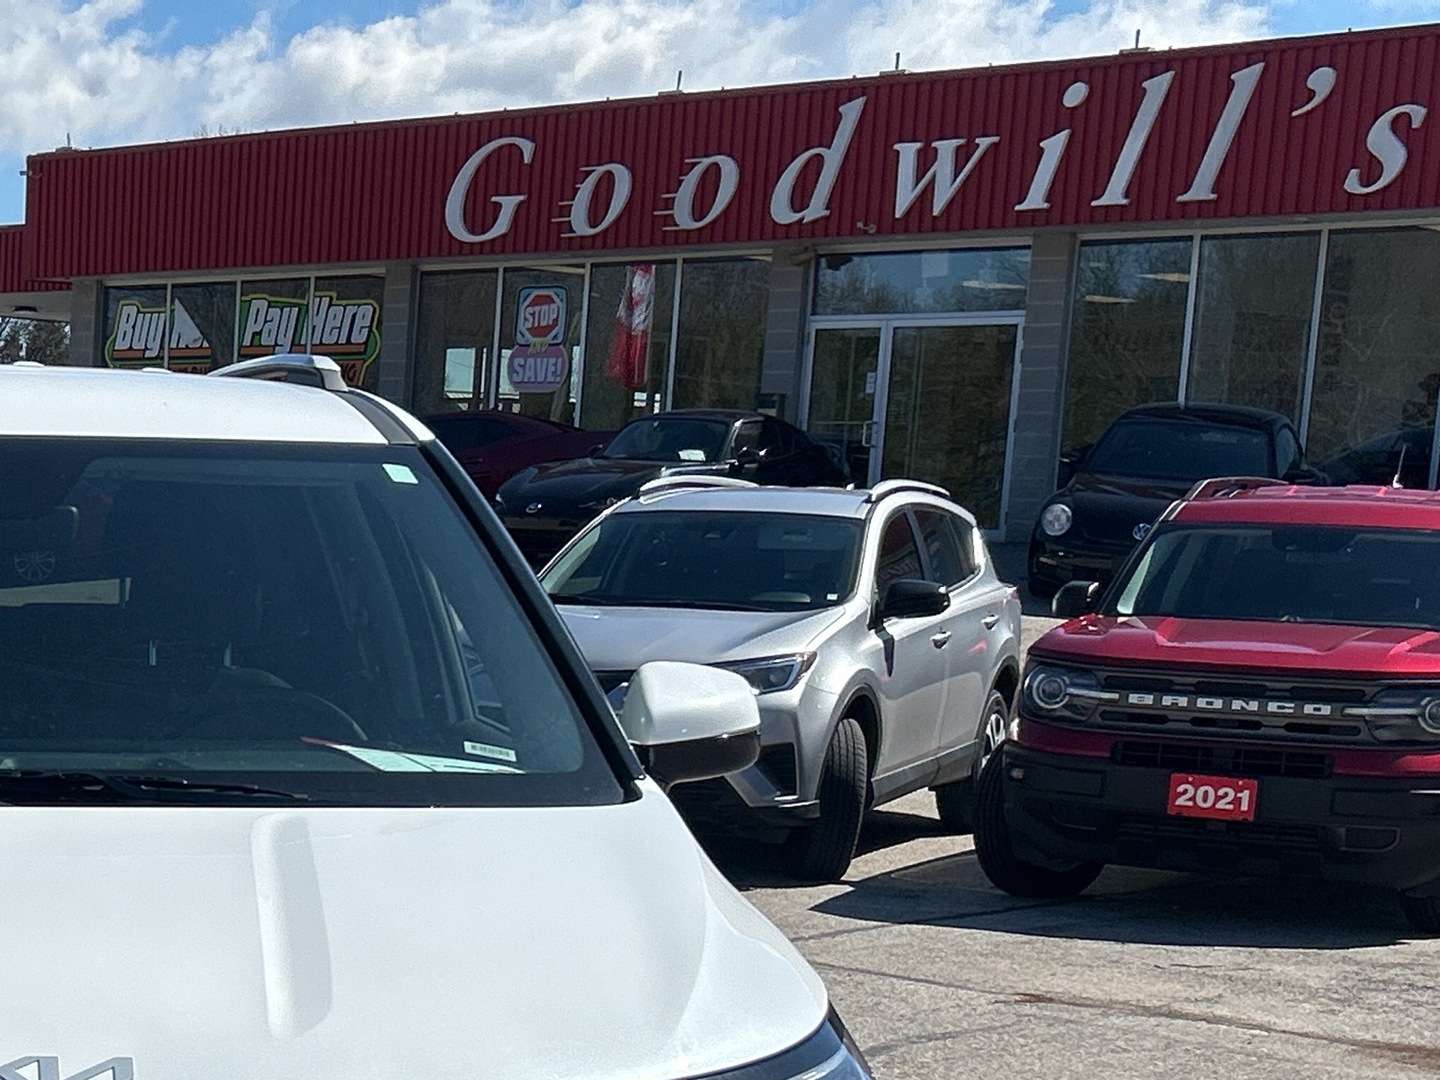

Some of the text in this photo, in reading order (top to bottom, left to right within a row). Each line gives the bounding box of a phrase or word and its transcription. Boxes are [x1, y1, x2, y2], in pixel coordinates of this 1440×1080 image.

[444, 62, 1428, 243] Goodwill's
[242, 299, 299, 355] Pay
[300, 296, 374, 345] Here
[524, 304, 559, 328] STOP
[114, 305, 167, 358] Buy
[511, 357, 563, 382] SAVE!
[1128, 693, 1332, 716] BRONCO
[1175, 784, 1251, 811] 2021
